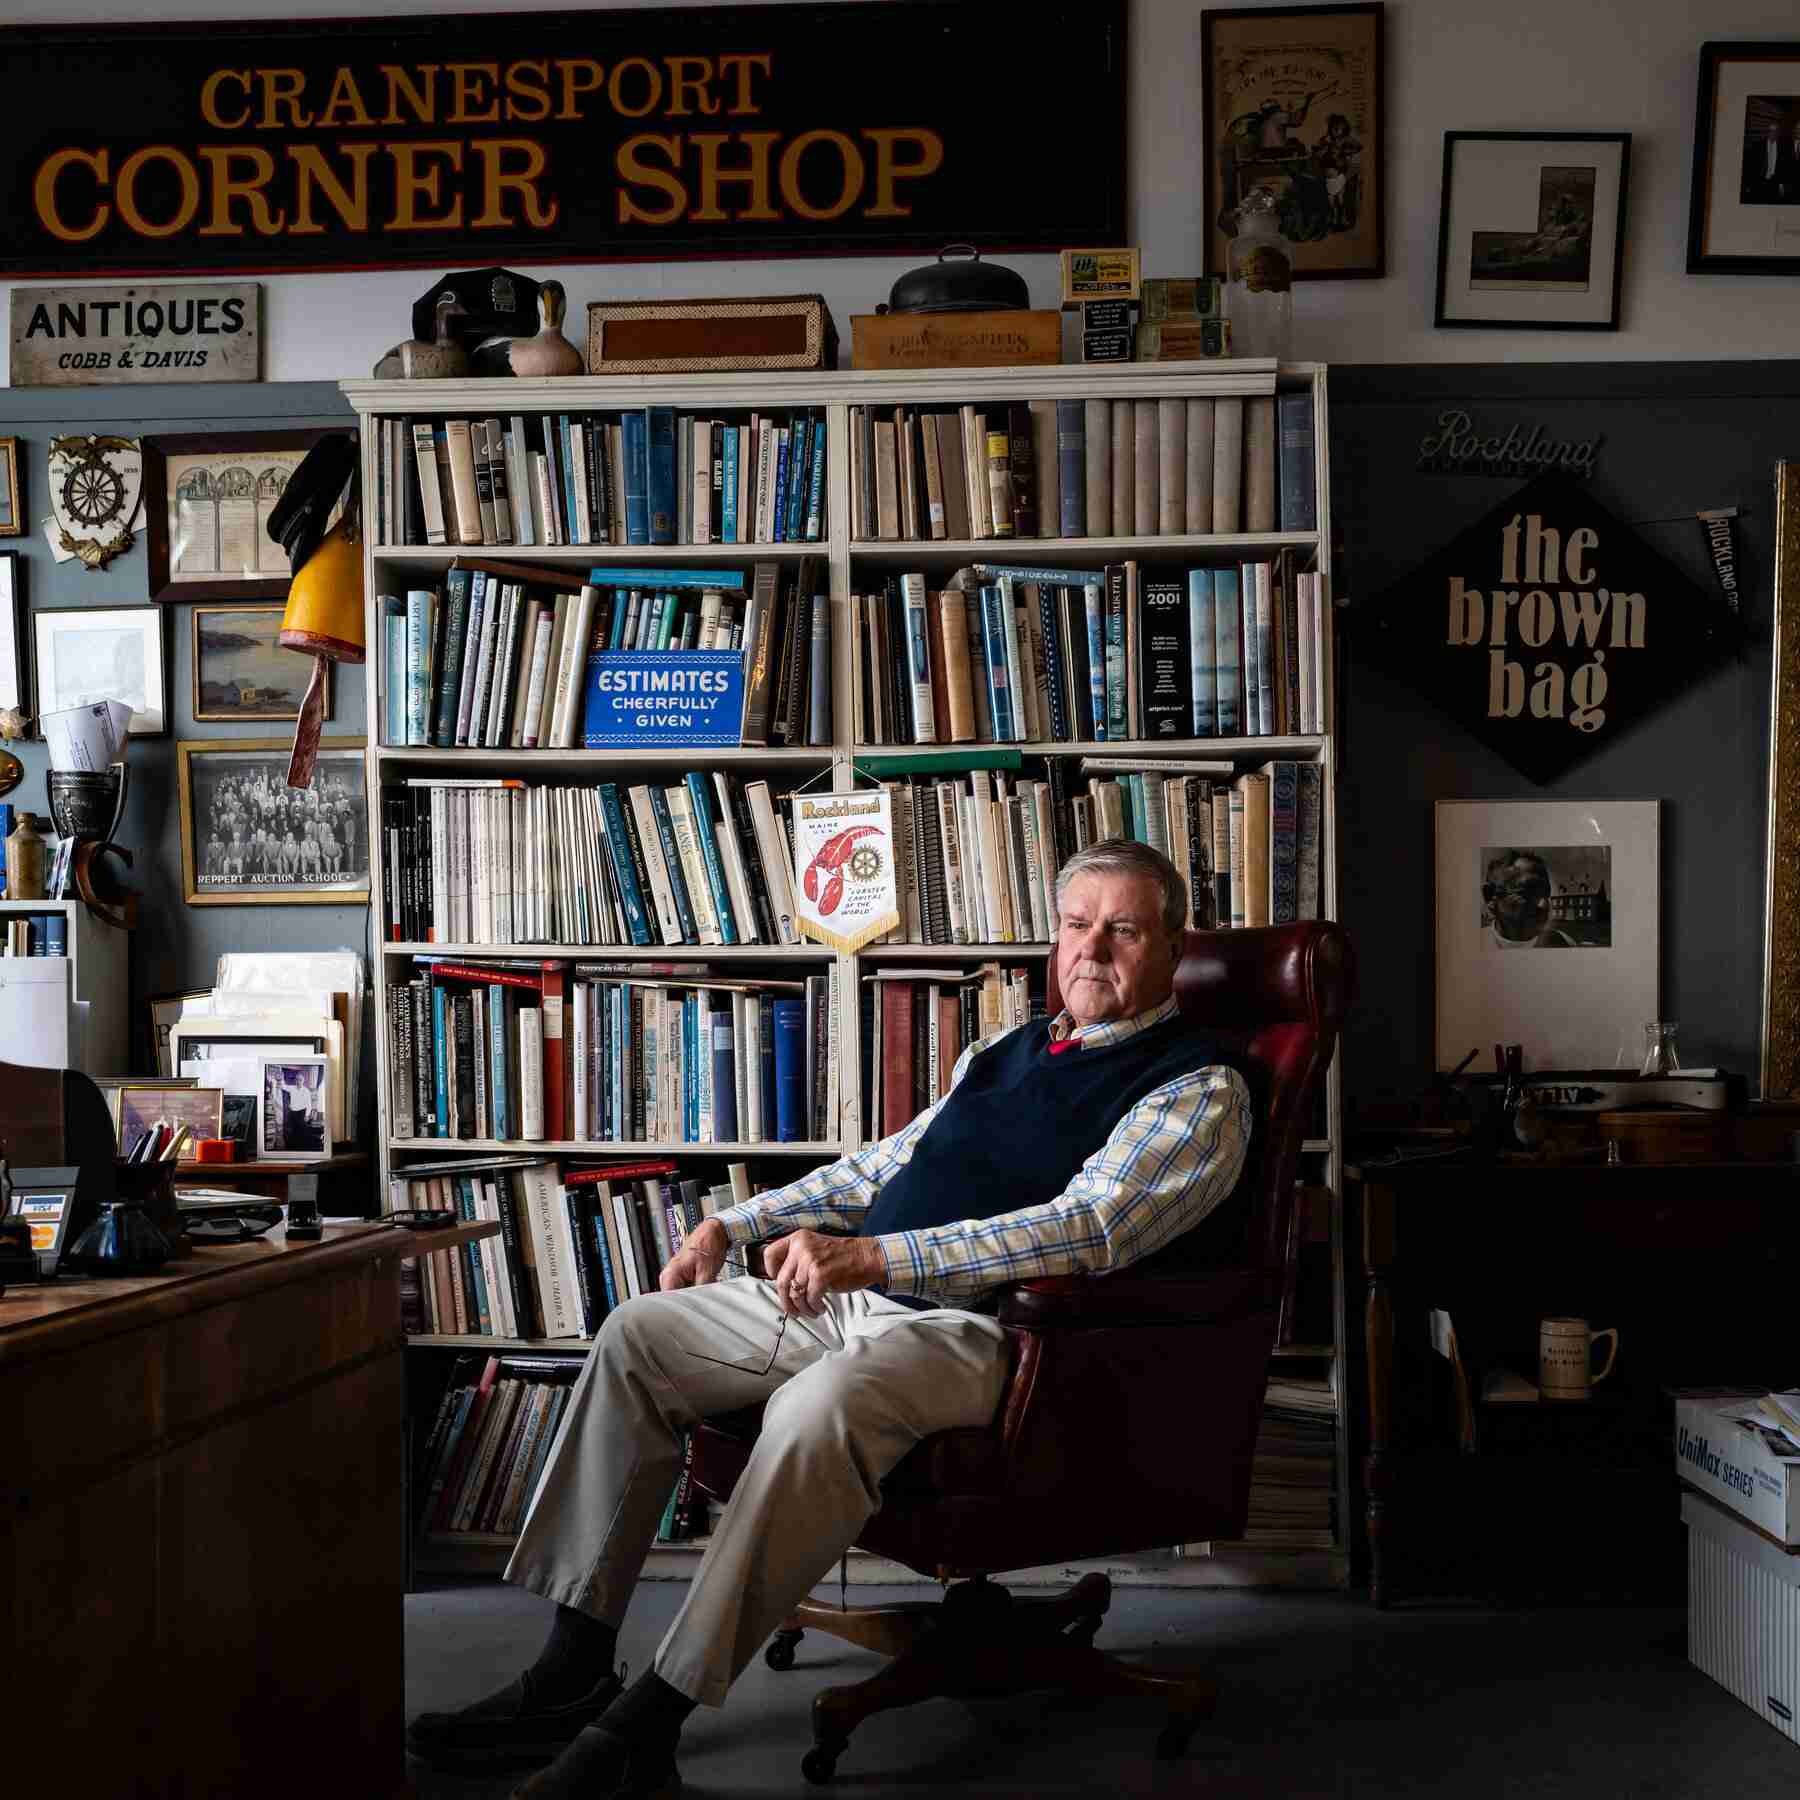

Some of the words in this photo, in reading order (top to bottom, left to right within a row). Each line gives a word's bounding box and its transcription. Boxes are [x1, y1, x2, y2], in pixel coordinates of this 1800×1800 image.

[201, 52, 772, 128] CRANESPORT
[34, 138, 558, 242] CORNER
[616, 128, 944, 224] SHOP
[26, 298, 245, 338] ANTIQUES
[58, 351, 111, 370] COBB
[117, 350, 133, 369] &
[141, 349, 208, 369] DAVIS
[1416, 408, 1602, 480] Rockland
[1500, 513, 1601, 584] the
[1705, 516, 1737, 591] ROCKLAND
[1147, 592, 1181, 605] 2001
[1444, 576, 1649, 648] brown
[599, 669, 729, 693] ESTIMATES
[1487, 648, 1610, 734] bag
[611, 697, 719, 710] CHEERFULLY
[636, 715, 692, 727] GIVEN
[801, 796, 882, 821] Rockland
[808, 822, 839, 830] MAINE
[197, 874, 244, 884] REPPERT
[250, 873, 296, 883] AUCTION
[301, 872, 345, 883] SCHOOL
[537, 1182, 551, 1230] AMERICAN
[543, 1231, 559, 1277] WINDSOR
[550, 1279, 564, 1315] CHAIRS
[1679, 1425, 1721, 1478] UniMax
[1722, 1462, 1755, 1498] SERIES
